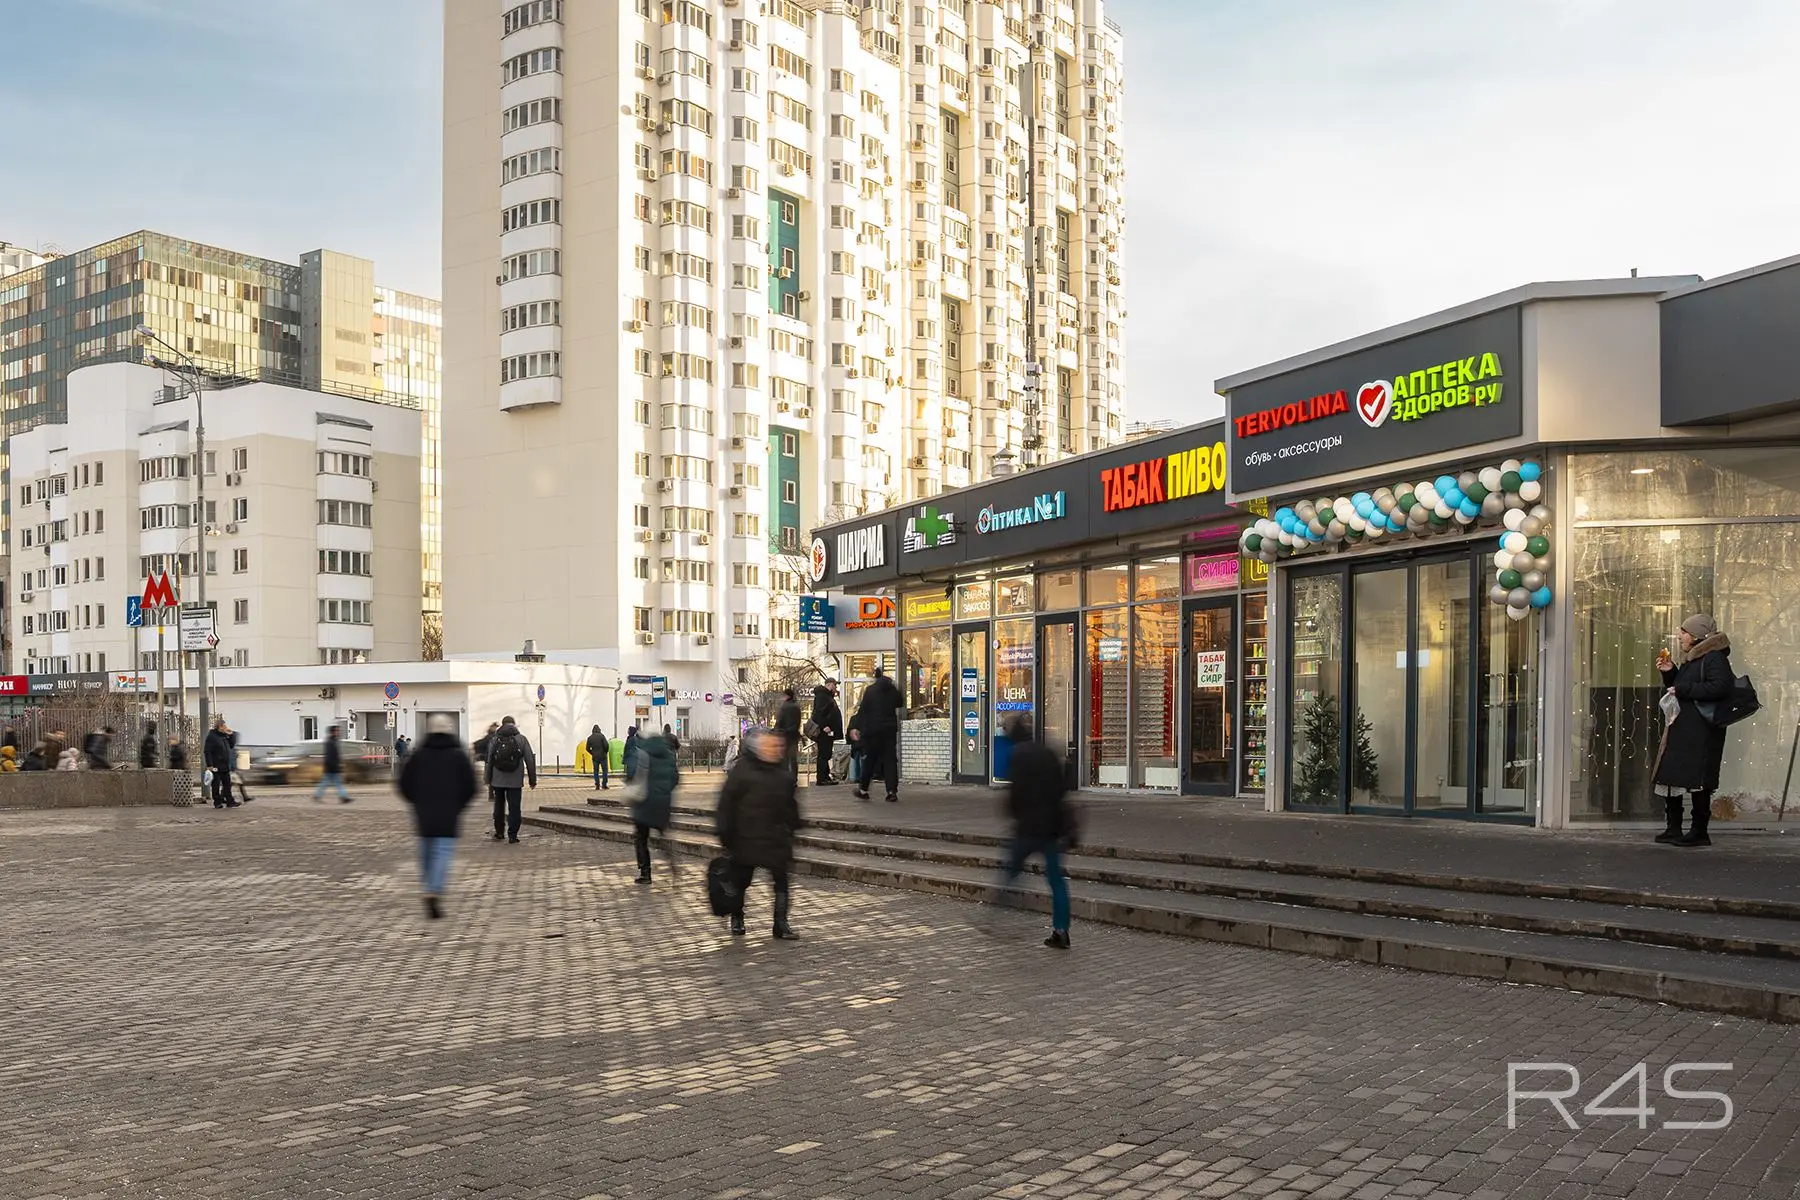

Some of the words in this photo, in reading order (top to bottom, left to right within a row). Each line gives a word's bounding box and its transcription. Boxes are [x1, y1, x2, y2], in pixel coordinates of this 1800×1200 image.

[1392, 352, 1502, 401] АПТЕКА
[1234, 389, 1350, 438] TERVOLINA
[1245, 451, 1272, 466] обувь
[1278, 435, 1342, 460] аксессуары
[1101, 457, 1166, 513] ТАБАК
[1167, 441, 1226, 500] ПИВО
[837, 524, 886, 574] ШАУРМА
[1199, 654, 1224, 663] ТАБАК
[1203, 663, 1220, 673] 24/7
[1200, 673, 1223, 683] СИДР
[1003, 687, 1027, 702] ЦЕНА
